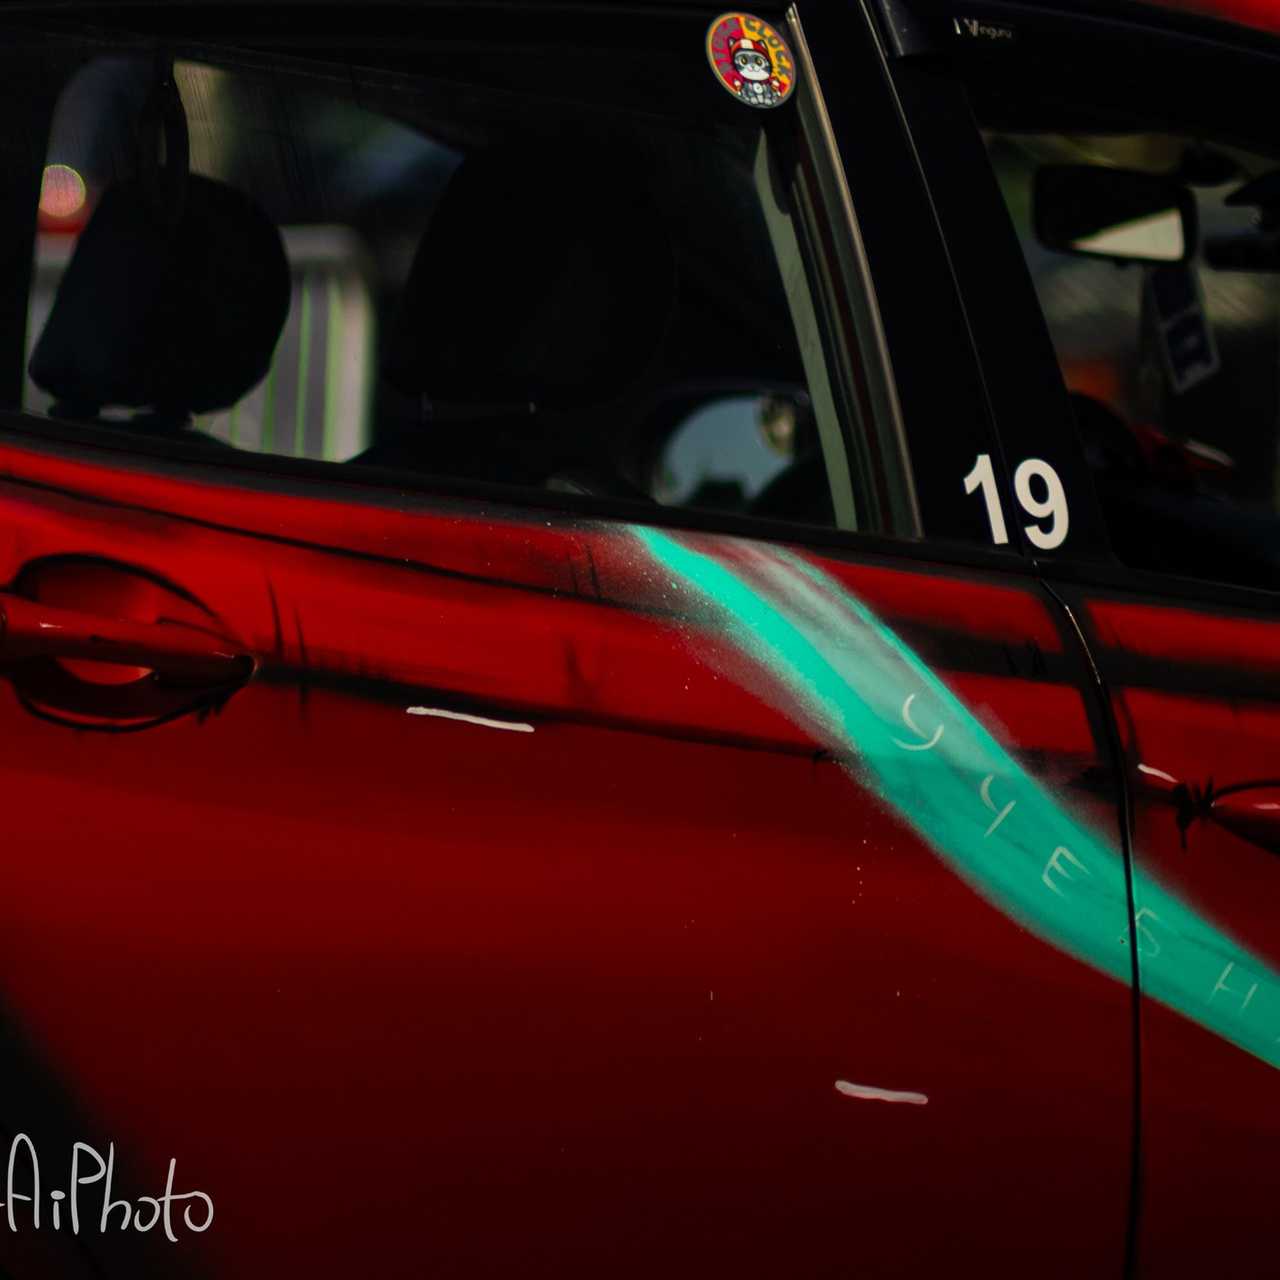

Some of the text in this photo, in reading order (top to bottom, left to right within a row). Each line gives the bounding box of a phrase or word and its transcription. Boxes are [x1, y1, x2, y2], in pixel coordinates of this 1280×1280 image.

[711, 17, 792, 79] STOCK CLOCK
[963, 454, 1069, 550] 19
[891, 693, 1280, 1043] УЧЕБН
